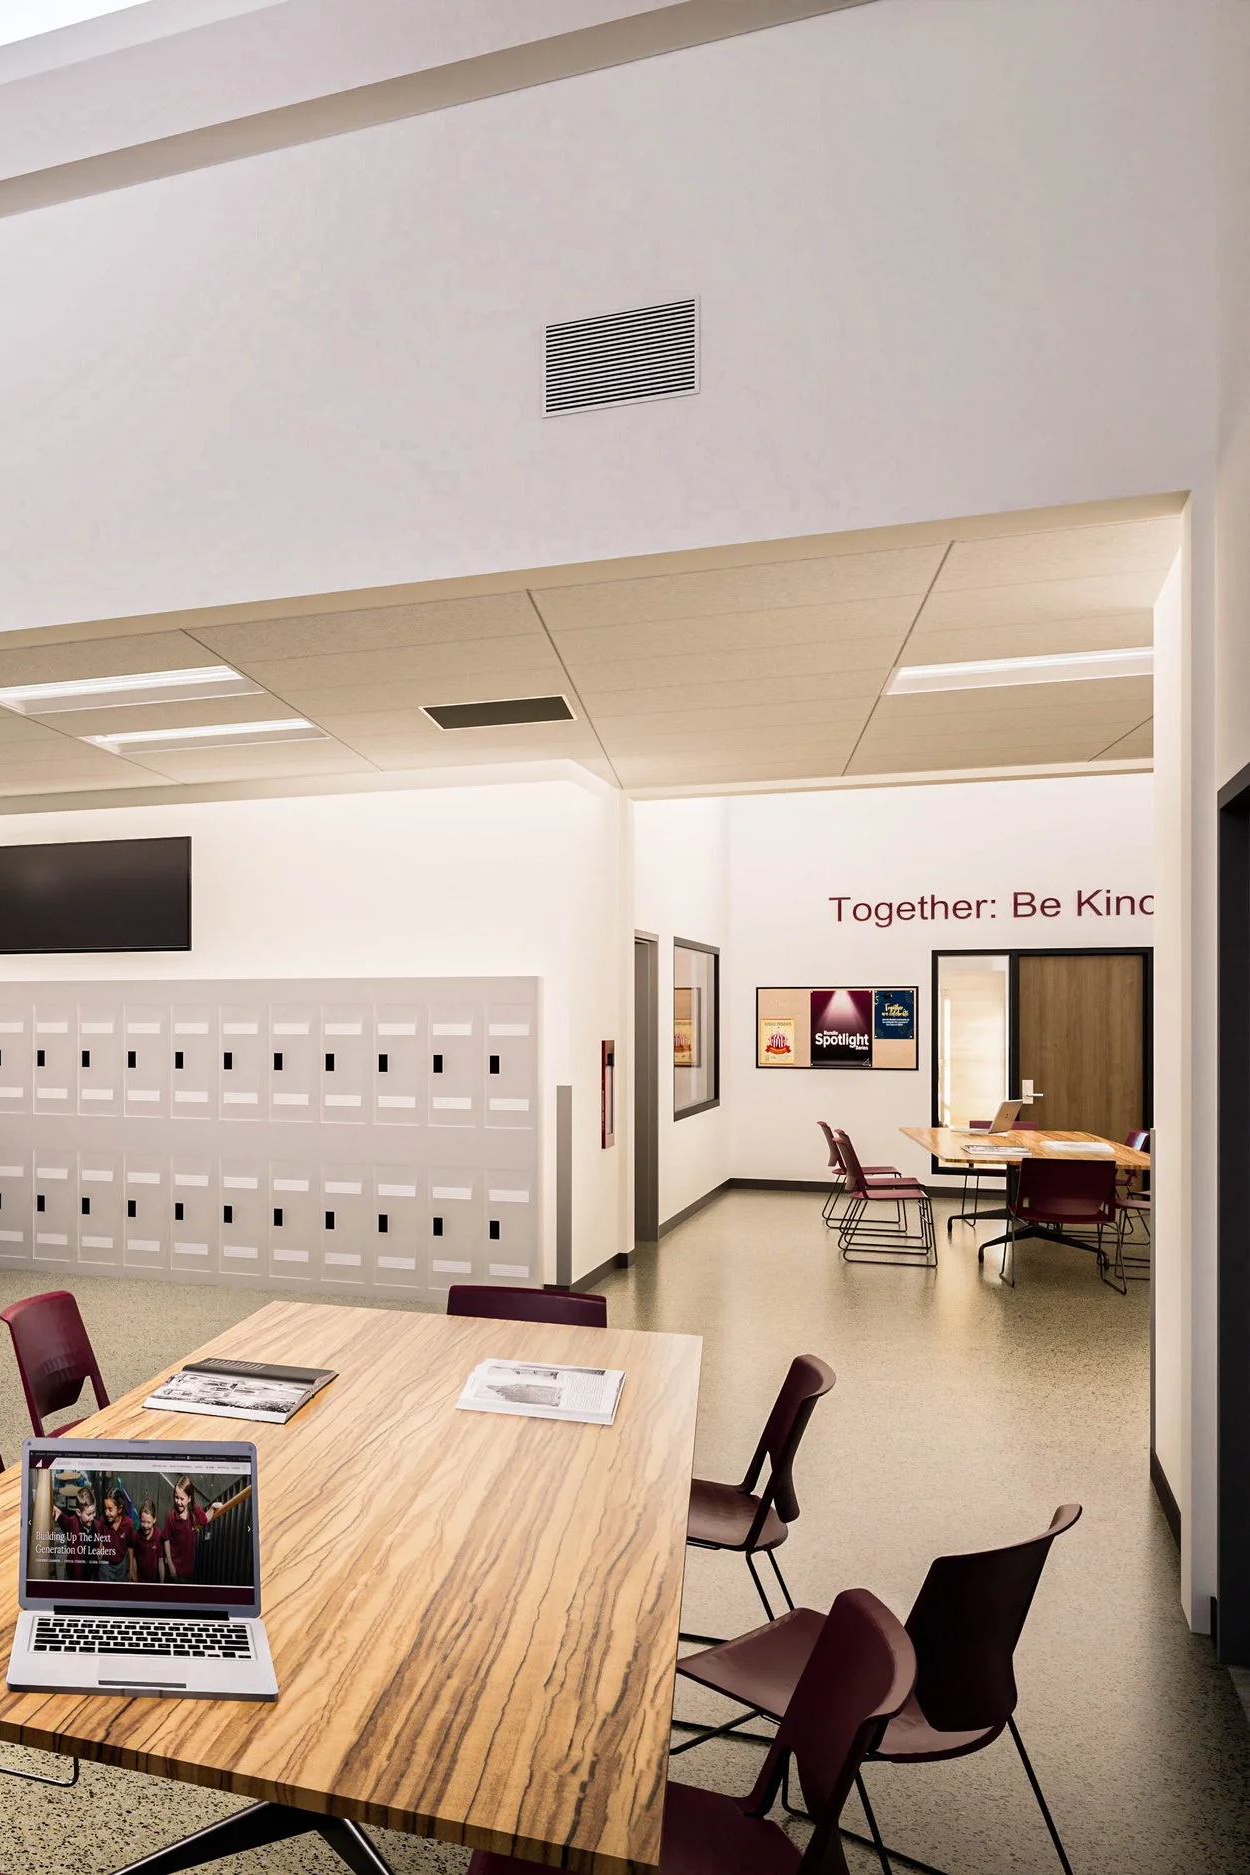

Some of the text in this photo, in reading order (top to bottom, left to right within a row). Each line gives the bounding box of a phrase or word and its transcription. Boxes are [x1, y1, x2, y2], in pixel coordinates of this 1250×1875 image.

[828, 894, 997, 928] Together:
[1012, 891, 1061, 918] Be
[815, 1033, 869, 1048] Spotlight
[35, 1531, 111, 1544] Building Up The Next
[35, 1544, 117, 1556] Generation Of Leaders
